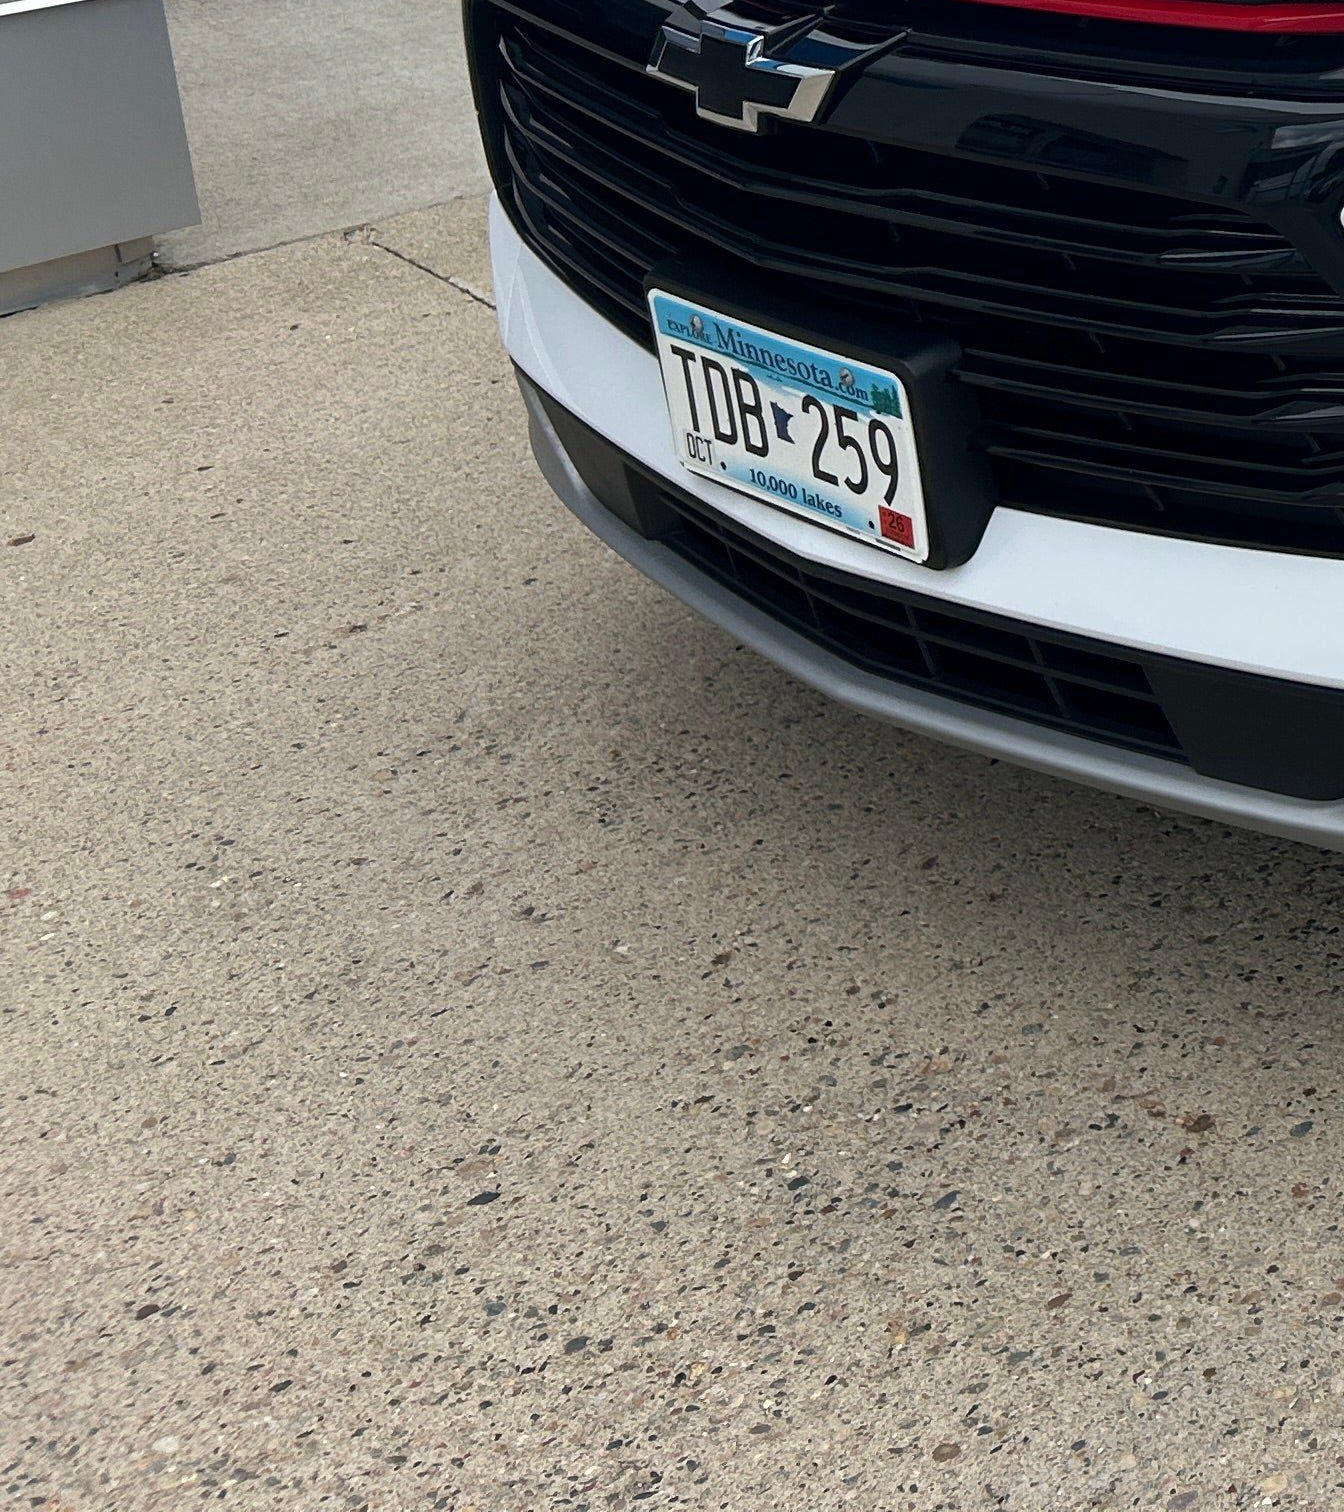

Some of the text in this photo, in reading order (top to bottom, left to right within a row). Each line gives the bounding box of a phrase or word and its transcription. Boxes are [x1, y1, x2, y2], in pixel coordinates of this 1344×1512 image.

[671, 343, 899, 507] TDB 259
[686, 432, 713, 466] OCT
[750, 468, 843, 518] 10,000 lakes
